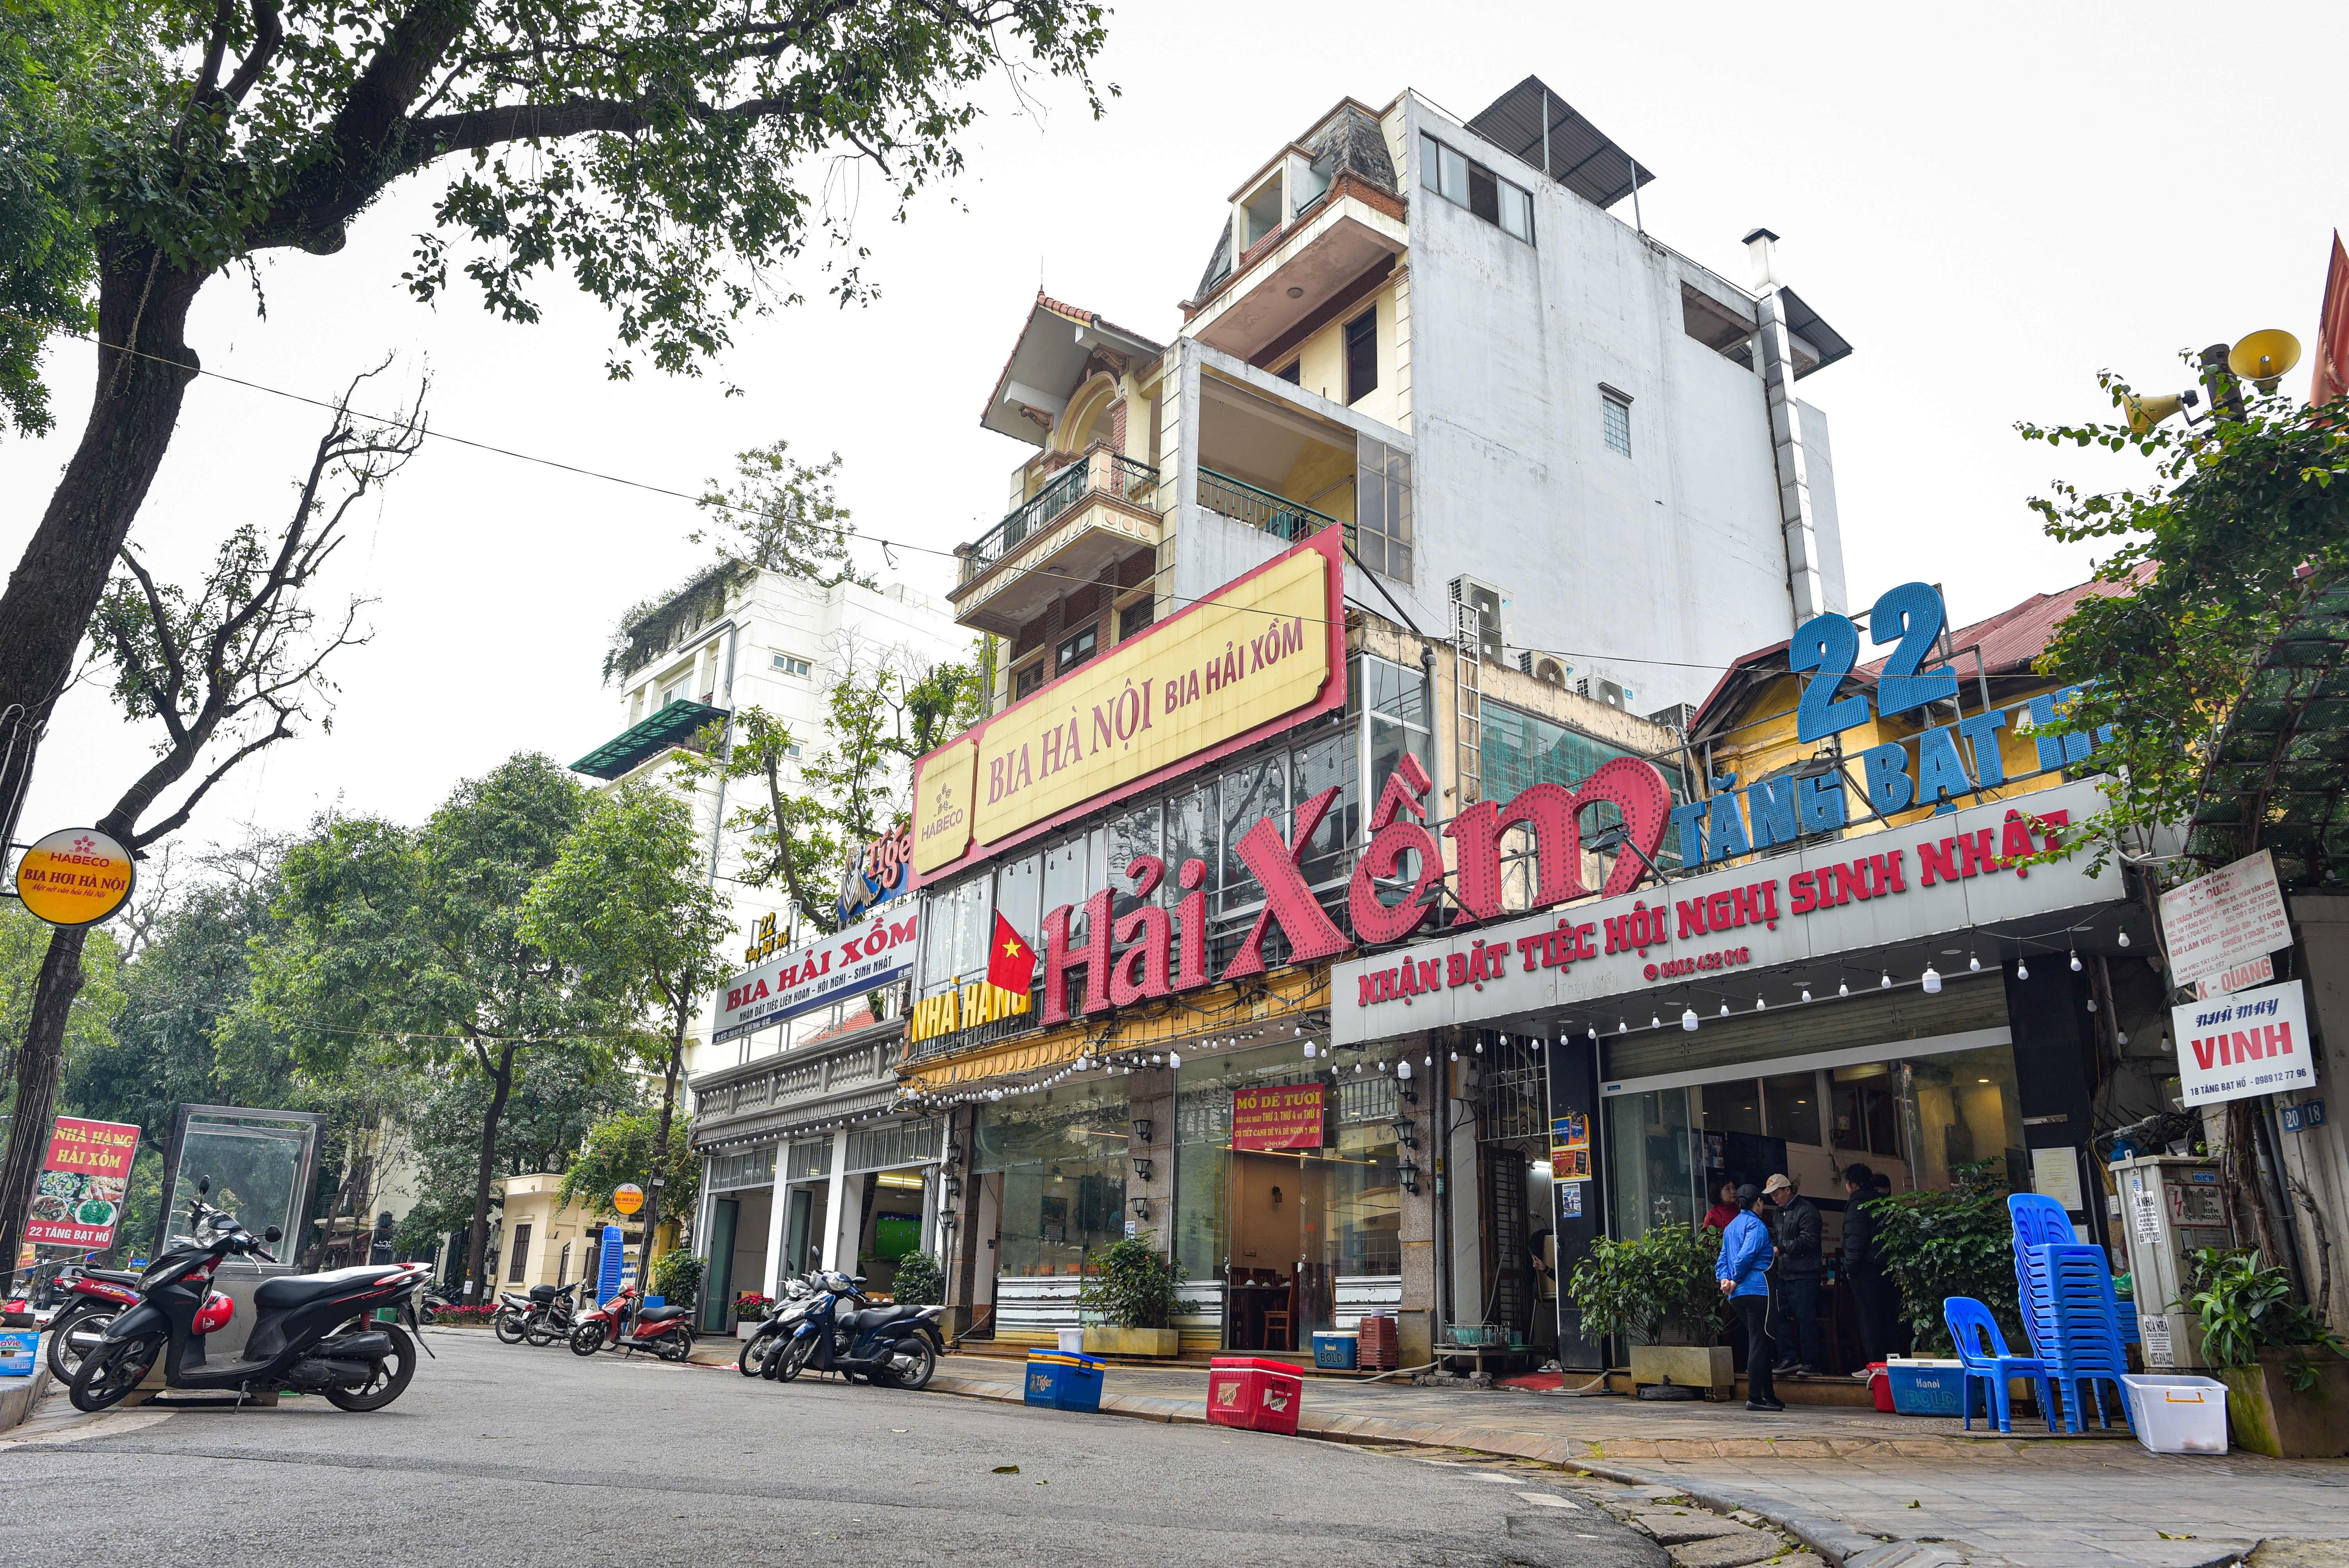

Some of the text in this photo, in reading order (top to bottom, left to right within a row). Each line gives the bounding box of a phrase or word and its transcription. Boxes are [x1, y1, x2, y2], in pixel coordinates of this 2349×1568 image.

[1790, 581, 1959, 744] 22
[987, 616, 1303, 805] BIA HÀ NỘI BIA HẢI XỒM
[1672, 769, 1847, 869] TĂNG
[1863, 708, 2005, 817] BẠT
[921, 808, 963, 842] HABECO
[50, 852, 110, 868] HABECO
[866, 821, 911, 889] Tige
[23, 868, 127, 893] BIA HƠI HÀ NỘI
[32, 883, 46, 891] Một
[71, 887, 82, 896] hóa
[96, 891, 107, 899] Nội
[1039, 752, 1671, 1027] Hải Xồm
[2164, 878, 2210, 905] PHÒNG KHÁM
[2189, 877, 2242, 907] X QUANG
[1358, 809, 2070, 1007] NHẬN ĐẶT TIỆC HỘI NGHỊ SINH NHẬT
[2176, 879, 2275, 925] TRÁCH CHUYÊN LONG
[2184, 921, 2199, 932] TĂNG
[2199, 916, 2209, 925] BẠT
[2232, 902, 2249, 912] 0243.
[2249, 889, 2276, 905] 8213333
[759, 912, 775, 941] 22
[2184, 909, 2281, 952] LÀM VIỆC: SÁNG 8h 11h30
[2245, 919, 2285, 940] 13h30 19h
[725, 915, 918, 1012] BIA HẢI XỒM
[745, 937, 774, 963] Tăng Bạt
[1660, 946, 1749, 978] 0903 432 016
[2188, 962, 2200, 971] VIỆC
[2247, 937, 2267, 948] TRONG
[739, 955, 893, 1022] NHẬN ĐẶT TIỆC LIÊN HOAN HỘI NGHỊ SINH NHẬT
[2197, 958, 2272, 1000] X QUANG
[912, 976, 959, 1042] NHÀ
[2190, 1021, 2294, 1070] VINH
[2190, 1068, 2307, 1096] 18 TĂNG BẠT HỔ 0989 12 77 96
[1237, 1090, 1321, 1110] MỔ DÊ TƯƠI
[1252, 1114, 1262, 1123] NGÀY
[1262, 1110, 1274, 1122] THỨ
[1274, 1112, 1279, 1122] 3,
[1280, 1108, 1292, 1121] THỨ
[1292, 1111, 1296, 1120] 4
[1297, 1112, 1302, 1120] VÀ
[1303, 1107, 1315, 1119] THỨ
[1316, 1109, 1320, 1119] 6
[2285, 1110, 2299, 1128] 20
[2306, 1105, 2321, 1123] 18
[54, 1126, 134, 1147] NHÀ HÀNG
[1235, 1124, 1320, 1137] CÓ TIẾT CANH DÊ VÀ DÊ NGON 7 MÓN
[56, 1146, 122, 1168] HẢI XỒM
[2141, 1194, 2154, 1207] NHÀ
[28, 1226, 111, 1242] 22 TĂNG BẠT HỔ
[2145, 1316, 2169, 1332] SỬA NHÀ
[1320, 1352, 1343, 1364] BOLD
[1036, 1374, 1053, 1392] Tiger
[1916, 1377, 1940, 1388] Hanoi
[1905, 1390, 1956, 1408] BOLD
